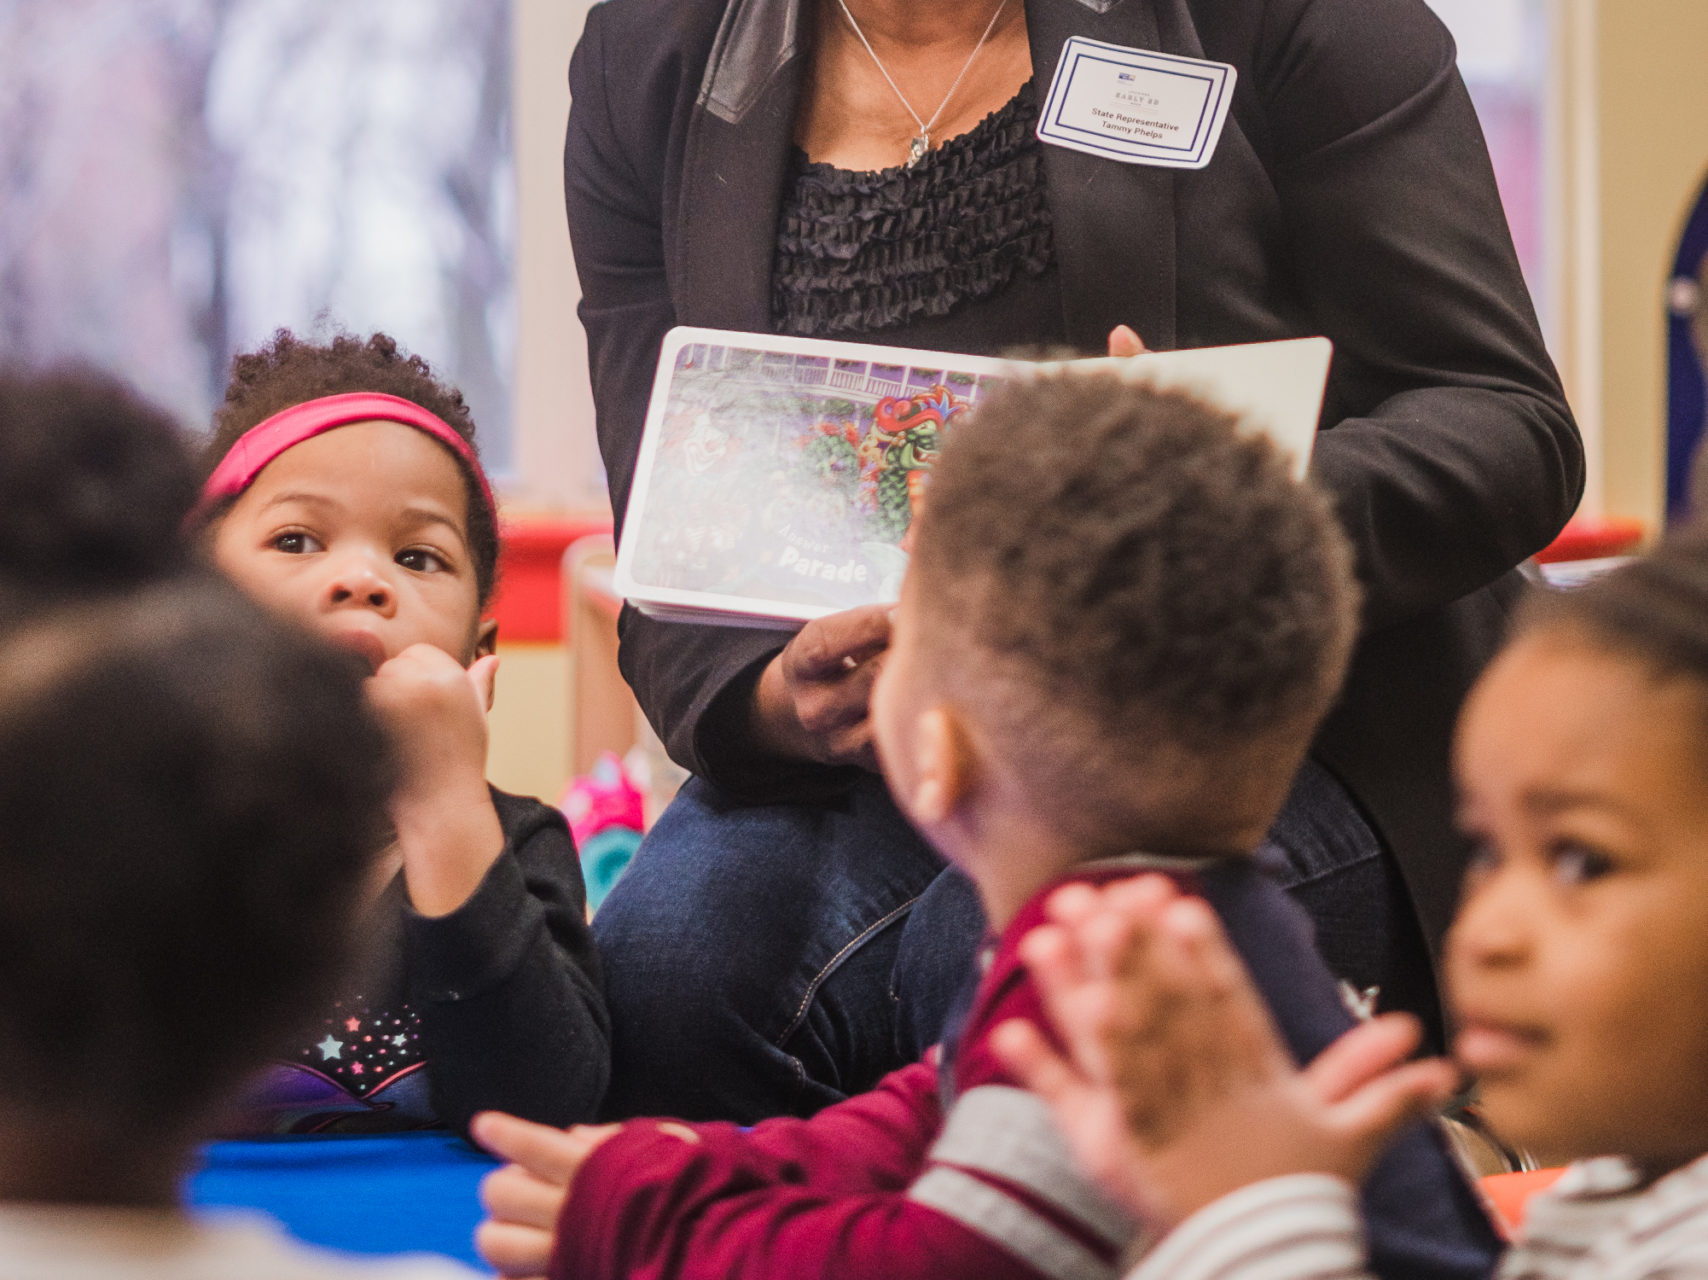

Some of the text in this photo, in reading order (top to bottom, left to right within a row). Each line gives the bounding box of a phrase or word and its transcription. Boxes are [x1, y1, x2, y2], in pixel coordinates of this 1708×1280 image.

[1091, 107, 1180, 131] State Representative
[1102, 120, 1163, 140] Tammy Phelps
[778, 545, 867, 584] Parade
